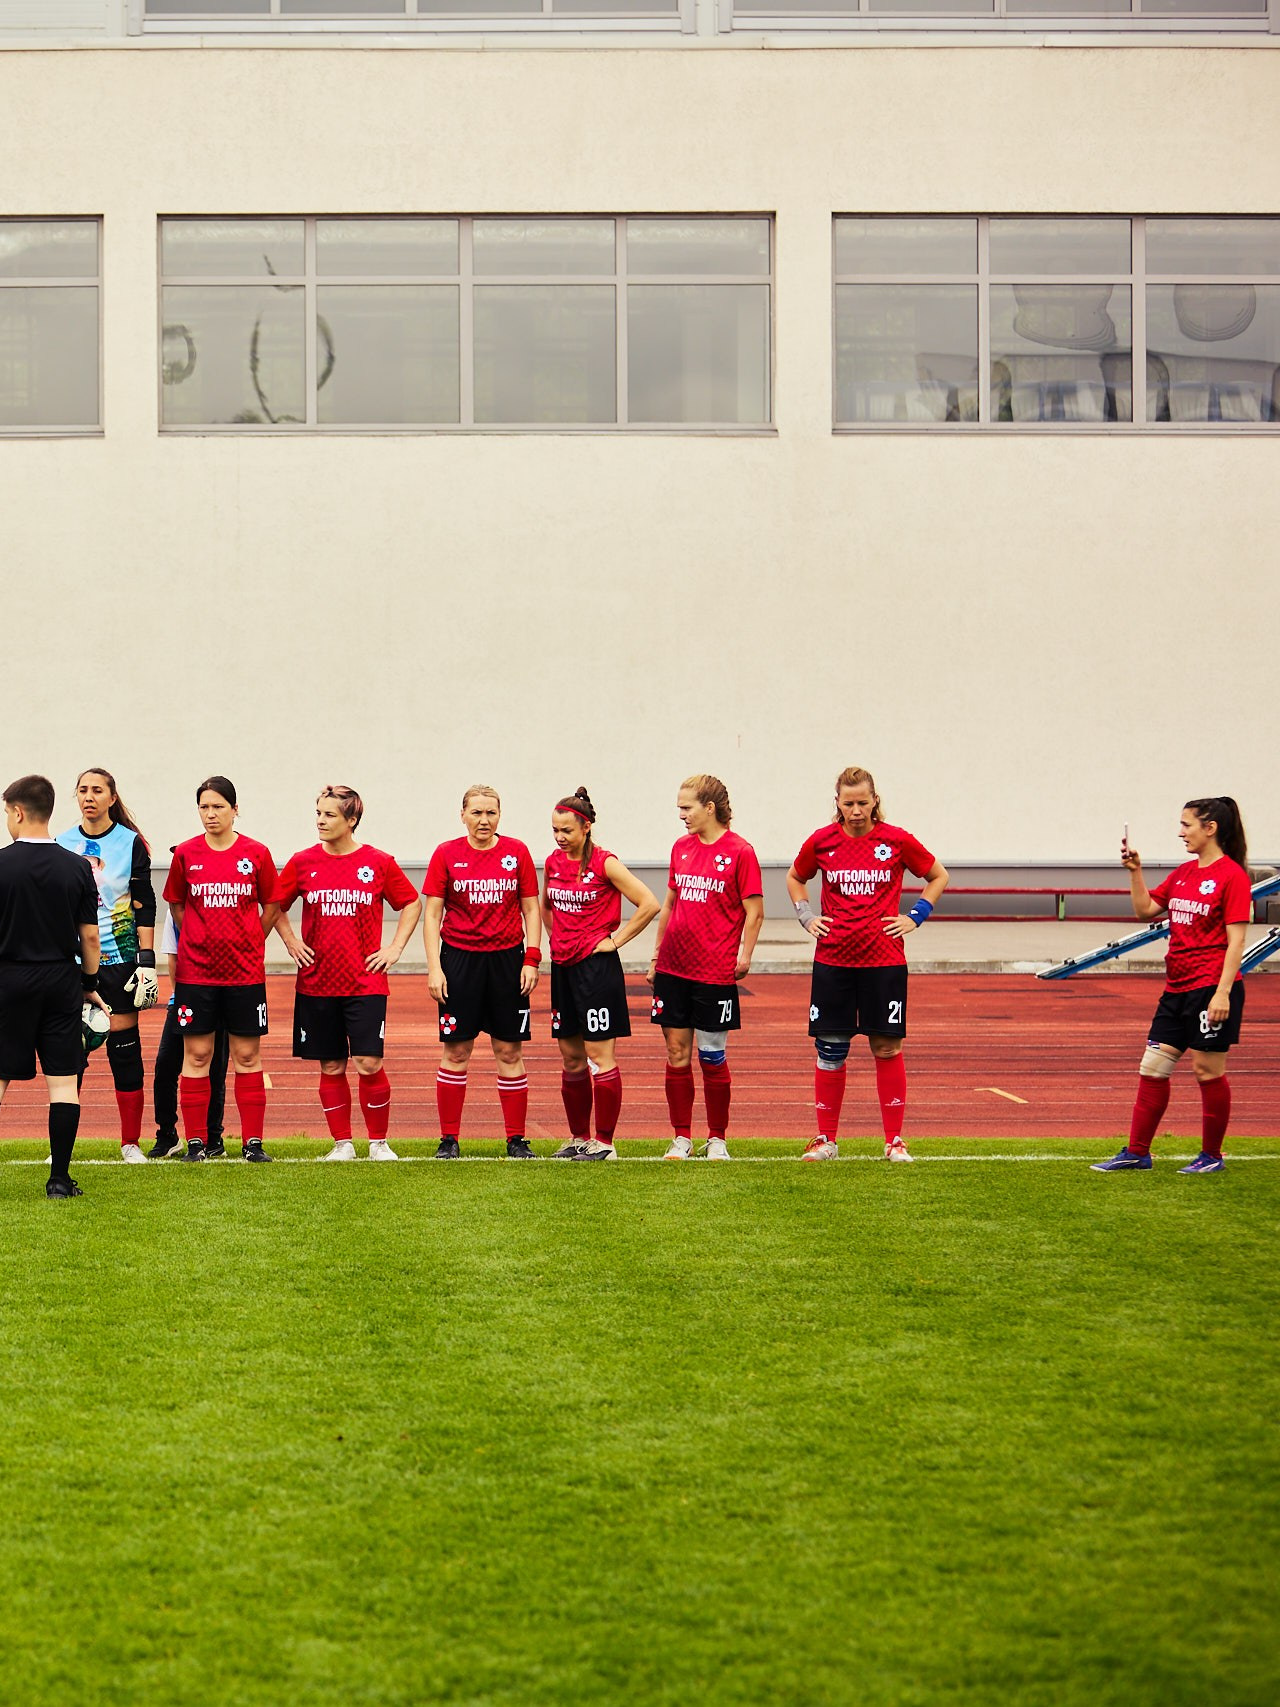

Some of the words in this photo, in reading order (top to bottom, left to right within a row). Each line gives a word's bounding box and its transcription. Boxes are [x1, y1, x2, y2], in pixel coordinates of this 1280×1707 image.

[826, 869, 891, 884] ФУТБОЛЬНАЯ
[453, 878, 518, 893] ФУТБОЛЬНАЯ
[840, 882, 875, 896] МАМА!
[203, 895, 238, 908] МАМА!
[307, 888, 373, 906] ФУТБОЛЬНАЯ
[469, 891, 504, 904] МАМА!
[680, 887, 709, 903] МАМА!
[321, 902, 357, 916] МАМА!
[256, 1002, 267, 1028] 13
[718, 999, 733, 1024] 79
[888, 1000, 903, 1024] 21
[518, 1009, 531, 1034] 7
[587, 1007, 610, 1033] 69
